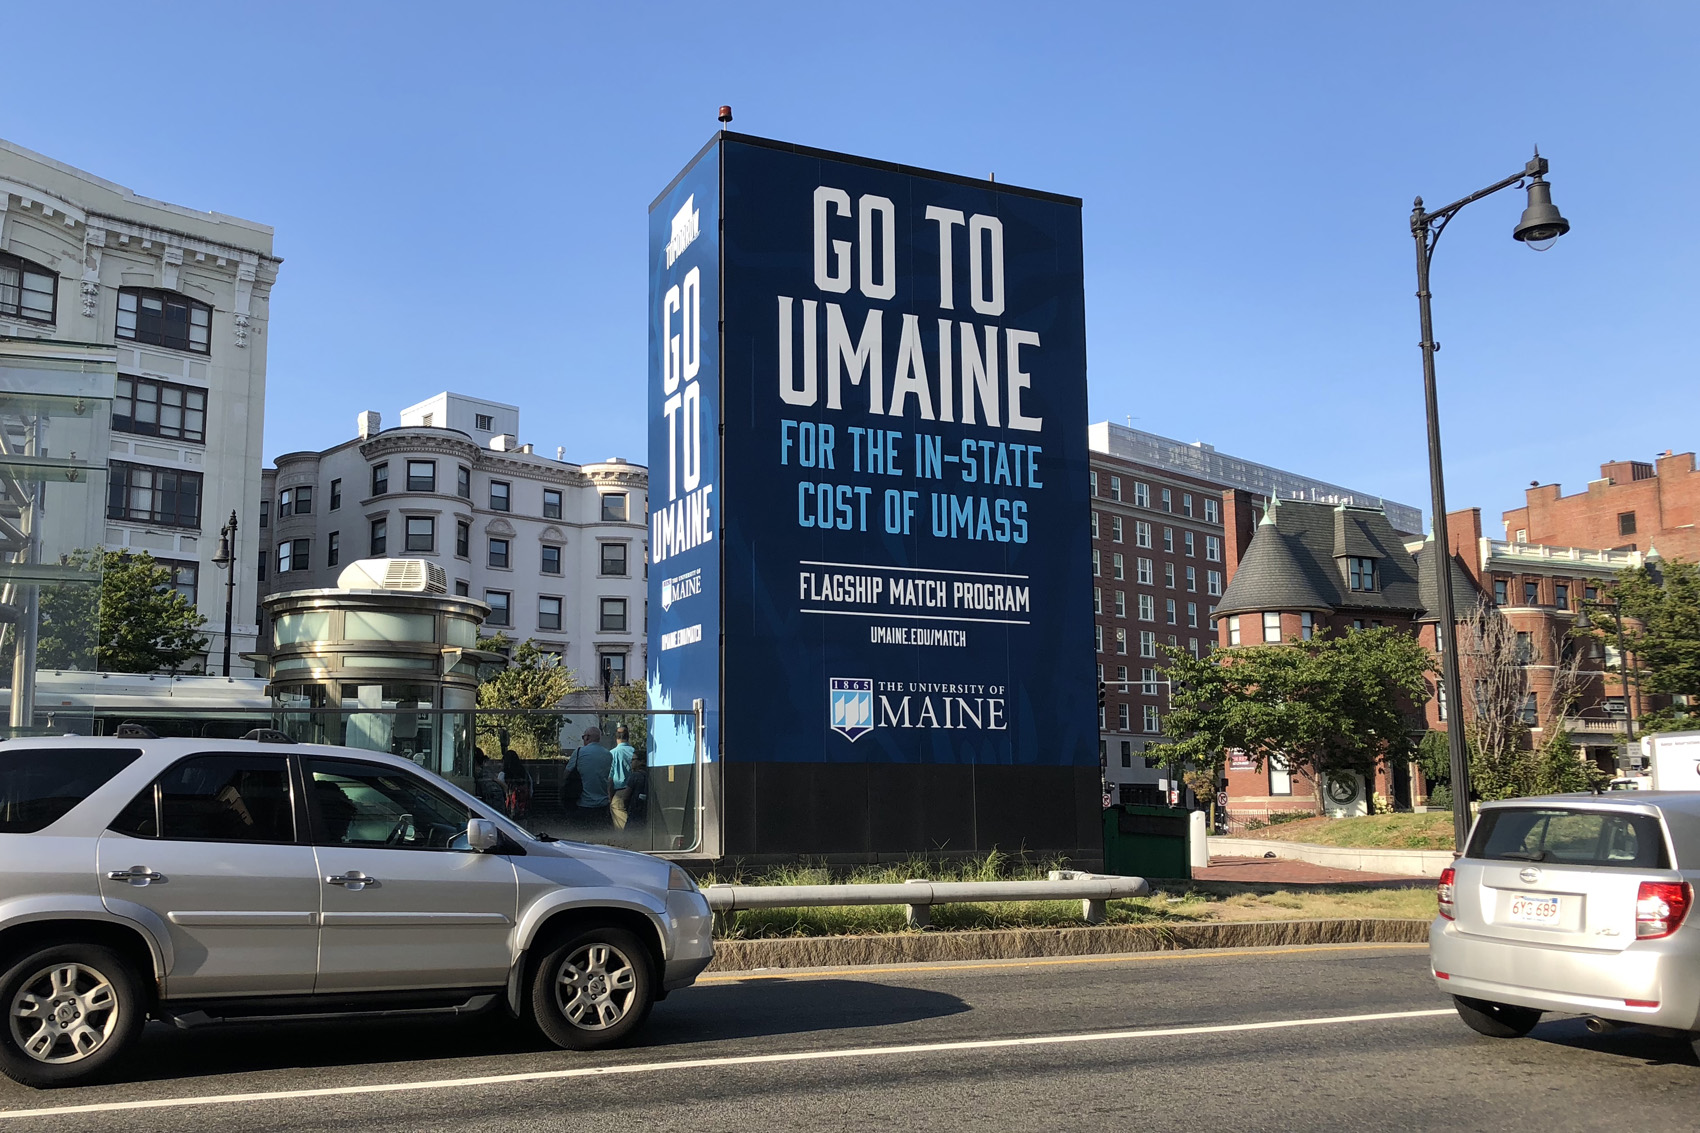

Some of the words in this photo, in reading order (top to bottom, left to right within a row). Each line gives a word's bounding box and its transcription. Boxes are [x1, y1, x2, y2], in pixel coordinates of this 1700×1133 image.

[813, 186, 896, 300] GO
[925, 205, 1005, 316] TO
[664, 265, 700, 396] GO
[777, 295, 1043, 432] UMAINE
[664, 380, 700, 502] TO
[780, 419, 835, 470] FOR
[848, 426, 903, 476] THE
[915, 433, 1043, 489] IN-STATE
[652, 484, 713, 564] UMAINE
[799, 481, 872, 532] COST
[884, 488, 919, 535] OF
[931, 492, 1028, 544] UMASS
[672, 576, 702, 603] MAINE
[800, 572, 882, 605] FLAGSHIP
[890, 578, 947, 609] MATCH
[954, 583, 1030, 613] PROGRAM
[871, 626, 967, 648] UMAINE.EDU/MATCH
[833, 680, 870, 690] 1865
[877, 695, 1008, 730] MAINE
[878, 681, 904, 692] THE
[909, 682, 985, 695] UNIVERSITY
[989, 685, 1005, 695] OF
